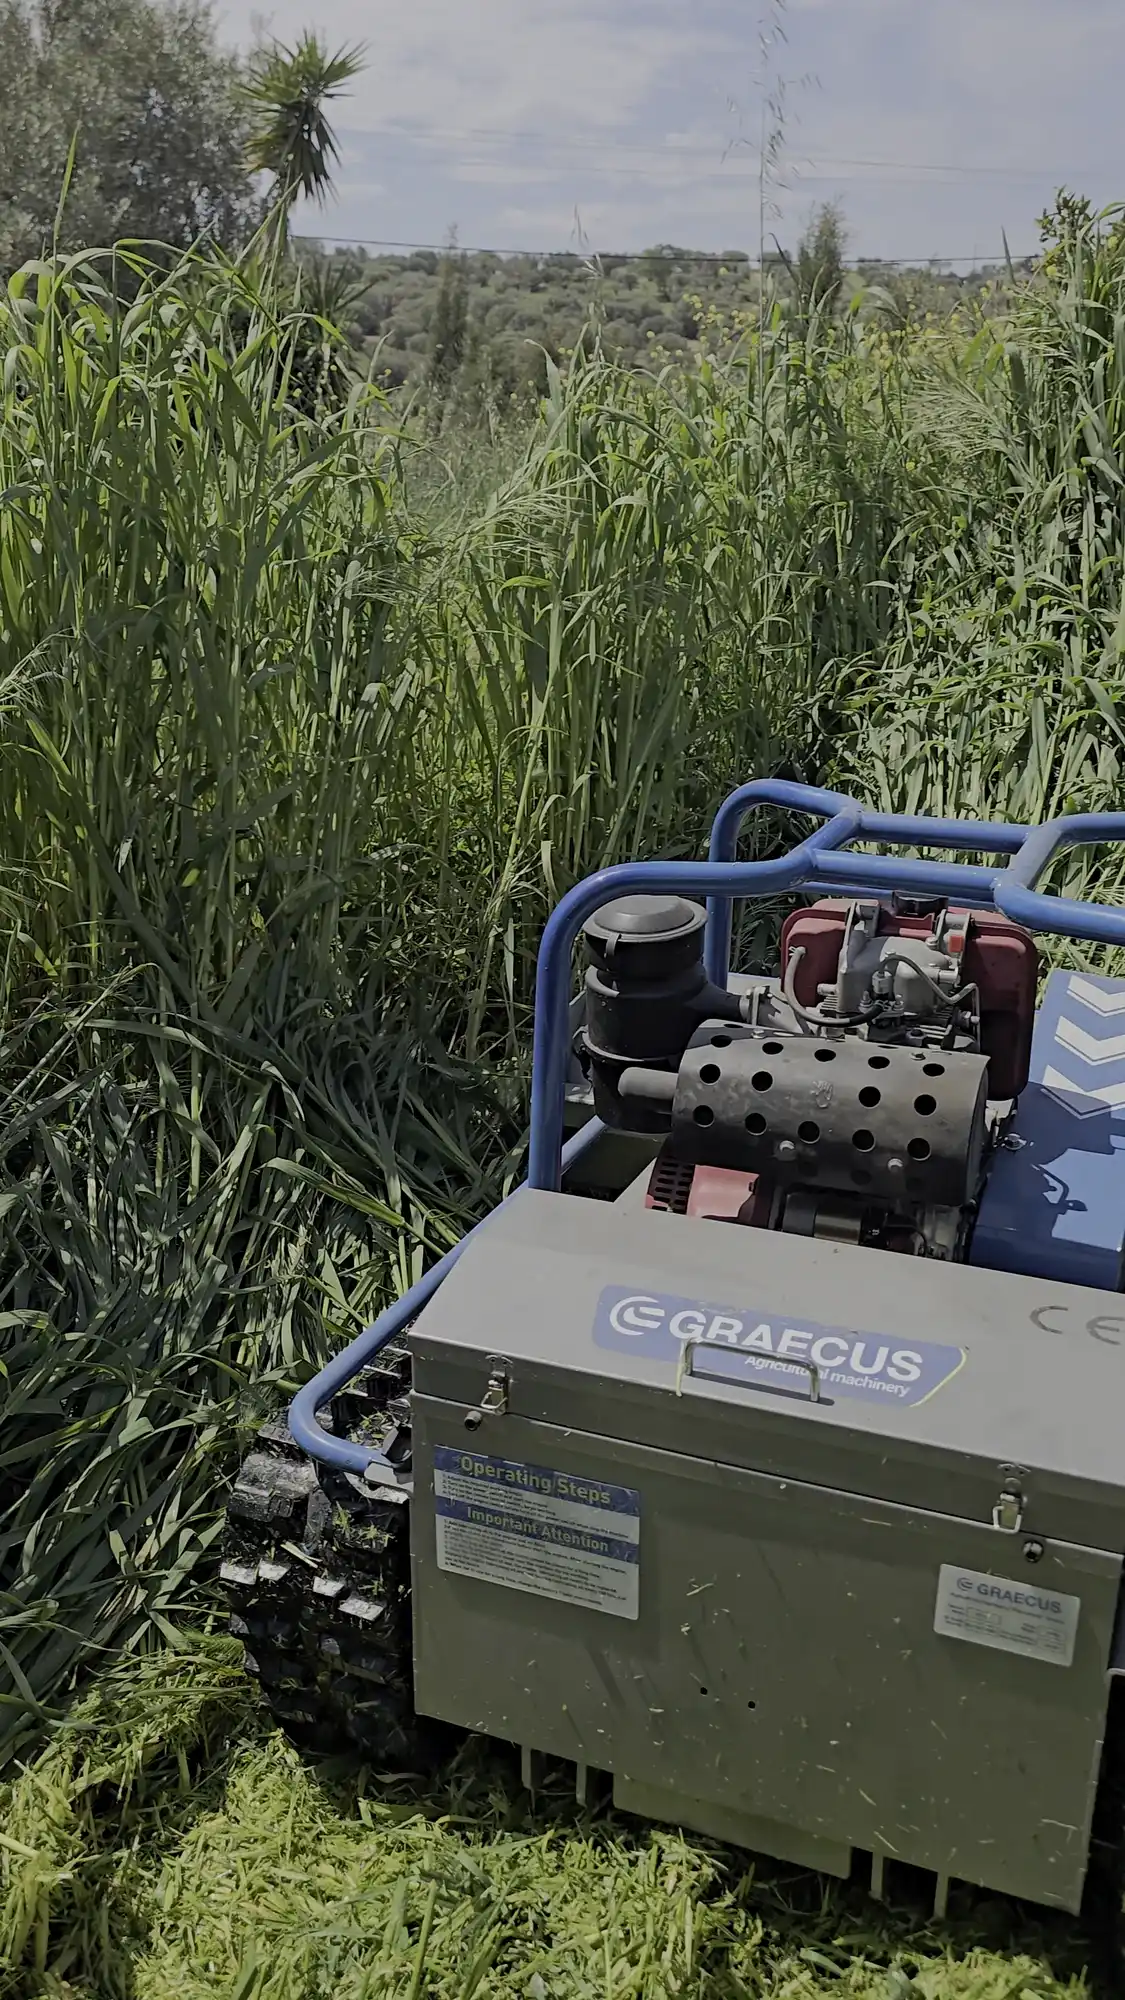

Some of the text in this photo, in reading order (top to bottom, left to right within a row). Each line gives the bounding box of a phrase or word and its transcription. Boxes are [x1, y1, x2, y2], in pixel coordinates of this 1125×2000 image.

[668, 1310, 923, 1382] GRAECUS
[1029, 1306, 1125, 1345] CE
[745, 1356, 911, 1397] Agricultual machinery
[461, 1456, 611, 1504] Operating Steps
[467, 1506, 537, 1533] Important
[541, 1525, 609, 1552] Attention
[977, 1583, 1062, 1613] GRAECUS
